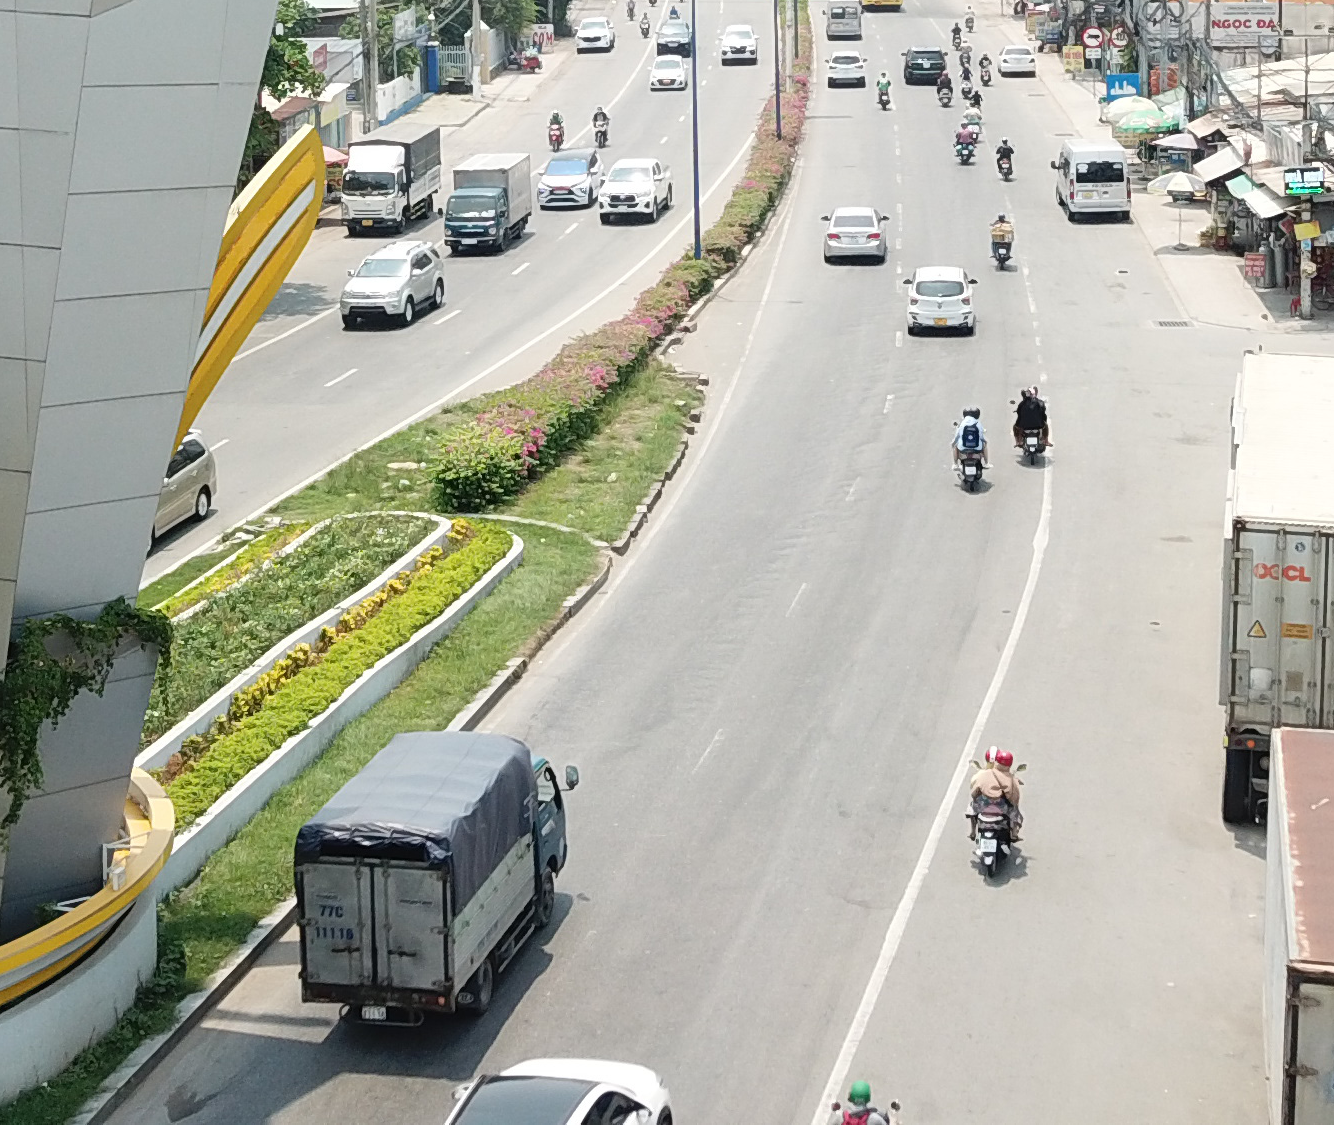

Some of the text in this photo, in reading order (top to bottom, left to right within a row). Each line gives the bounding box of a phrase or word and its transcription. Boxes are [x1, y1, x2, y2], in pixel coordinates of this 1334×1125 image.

[1212, 19, 1252, 30] NGỌC
[1253, 562, 1312, 582] OOCL
[319, 904, 344, 918] 77C
